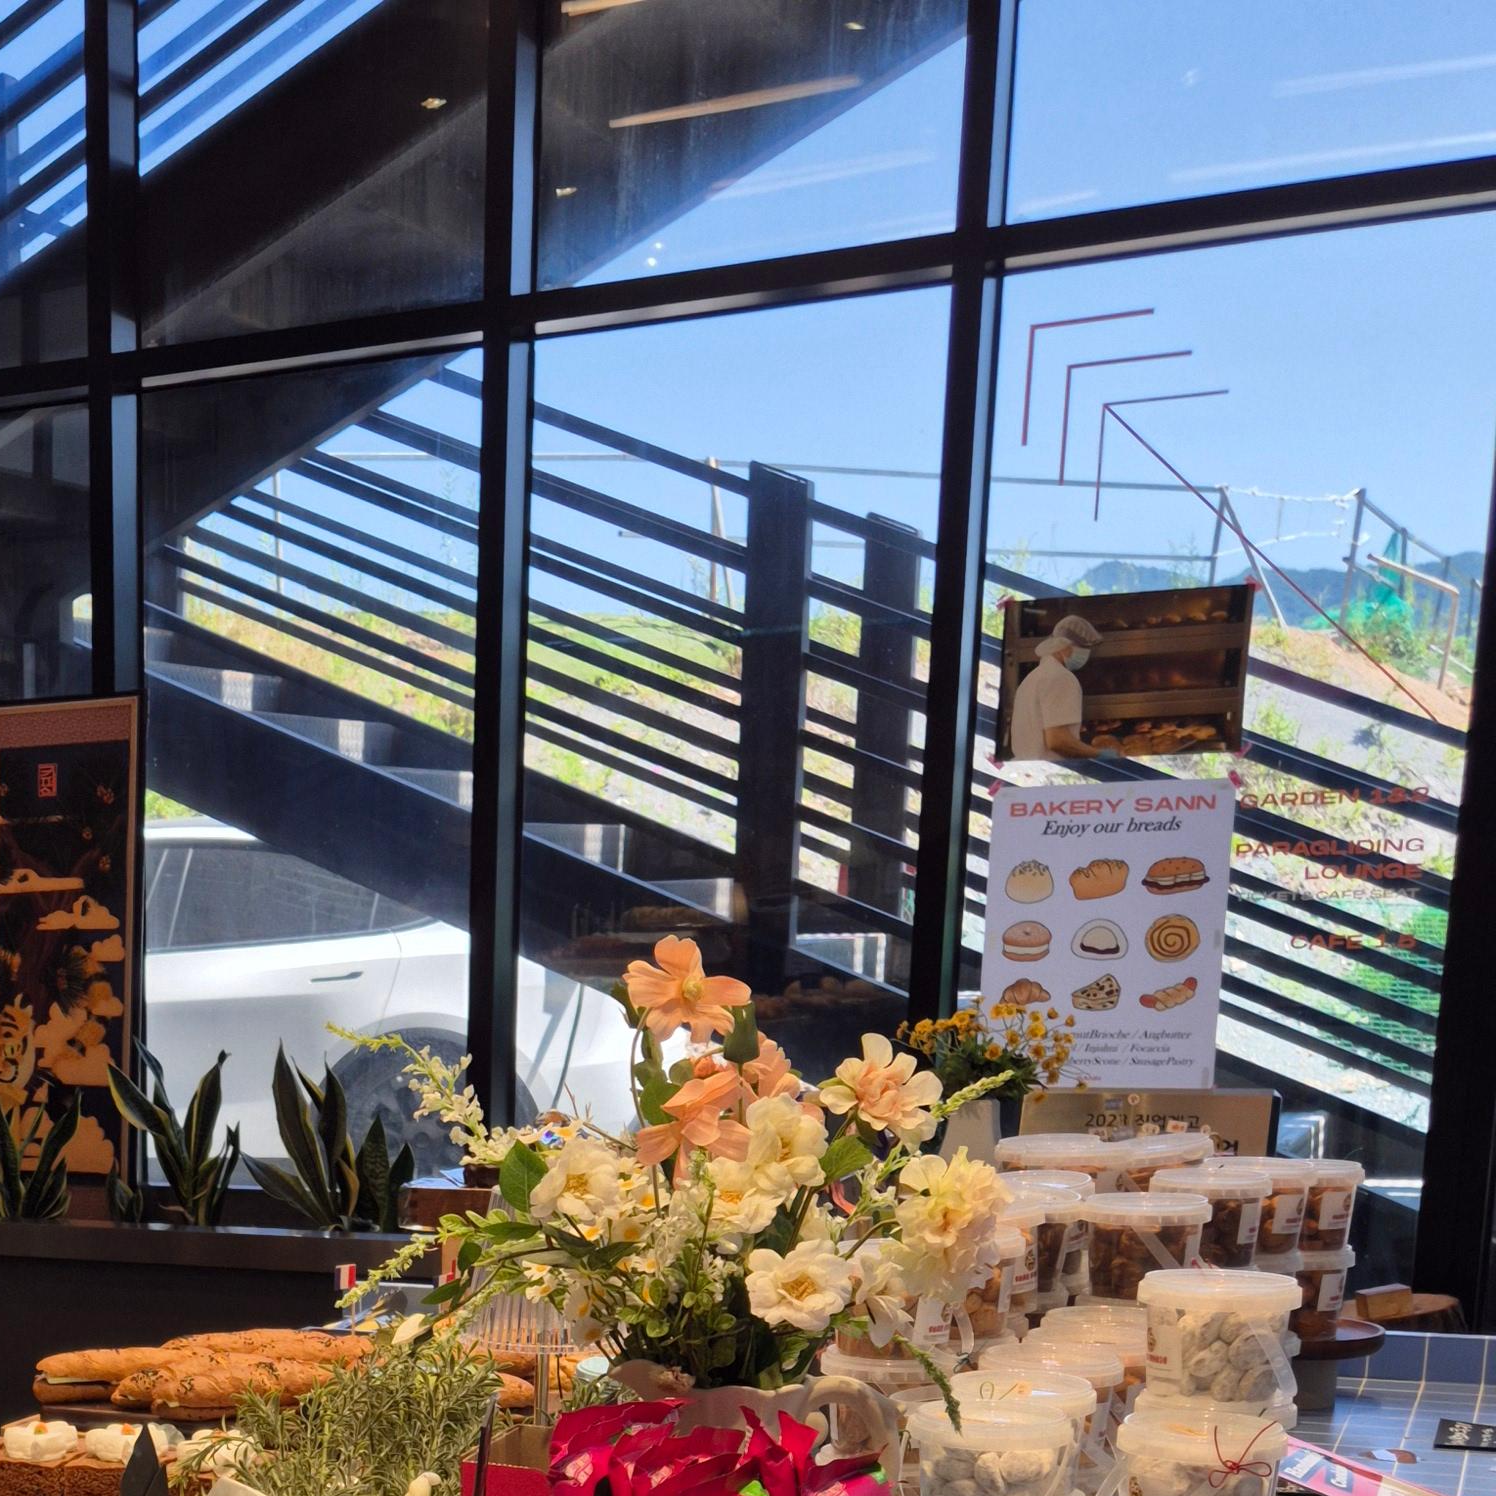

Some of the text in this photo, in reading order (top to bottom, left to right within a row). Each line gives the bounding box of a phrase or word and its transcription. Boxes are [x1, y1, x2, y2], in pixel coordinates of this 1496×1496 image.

[1010, 794, 1216, 817] BAKERY SANN
[1240, 788, 1359, 809] GARDEN
[1042, 816, 1182, 838] Enjoy our breads
[1235, 838, 1424, 857] PARAGLIDING
[1304, 863, 1423, 880] LOUNGE
[1291, 934, 1363, 951] CAFE
